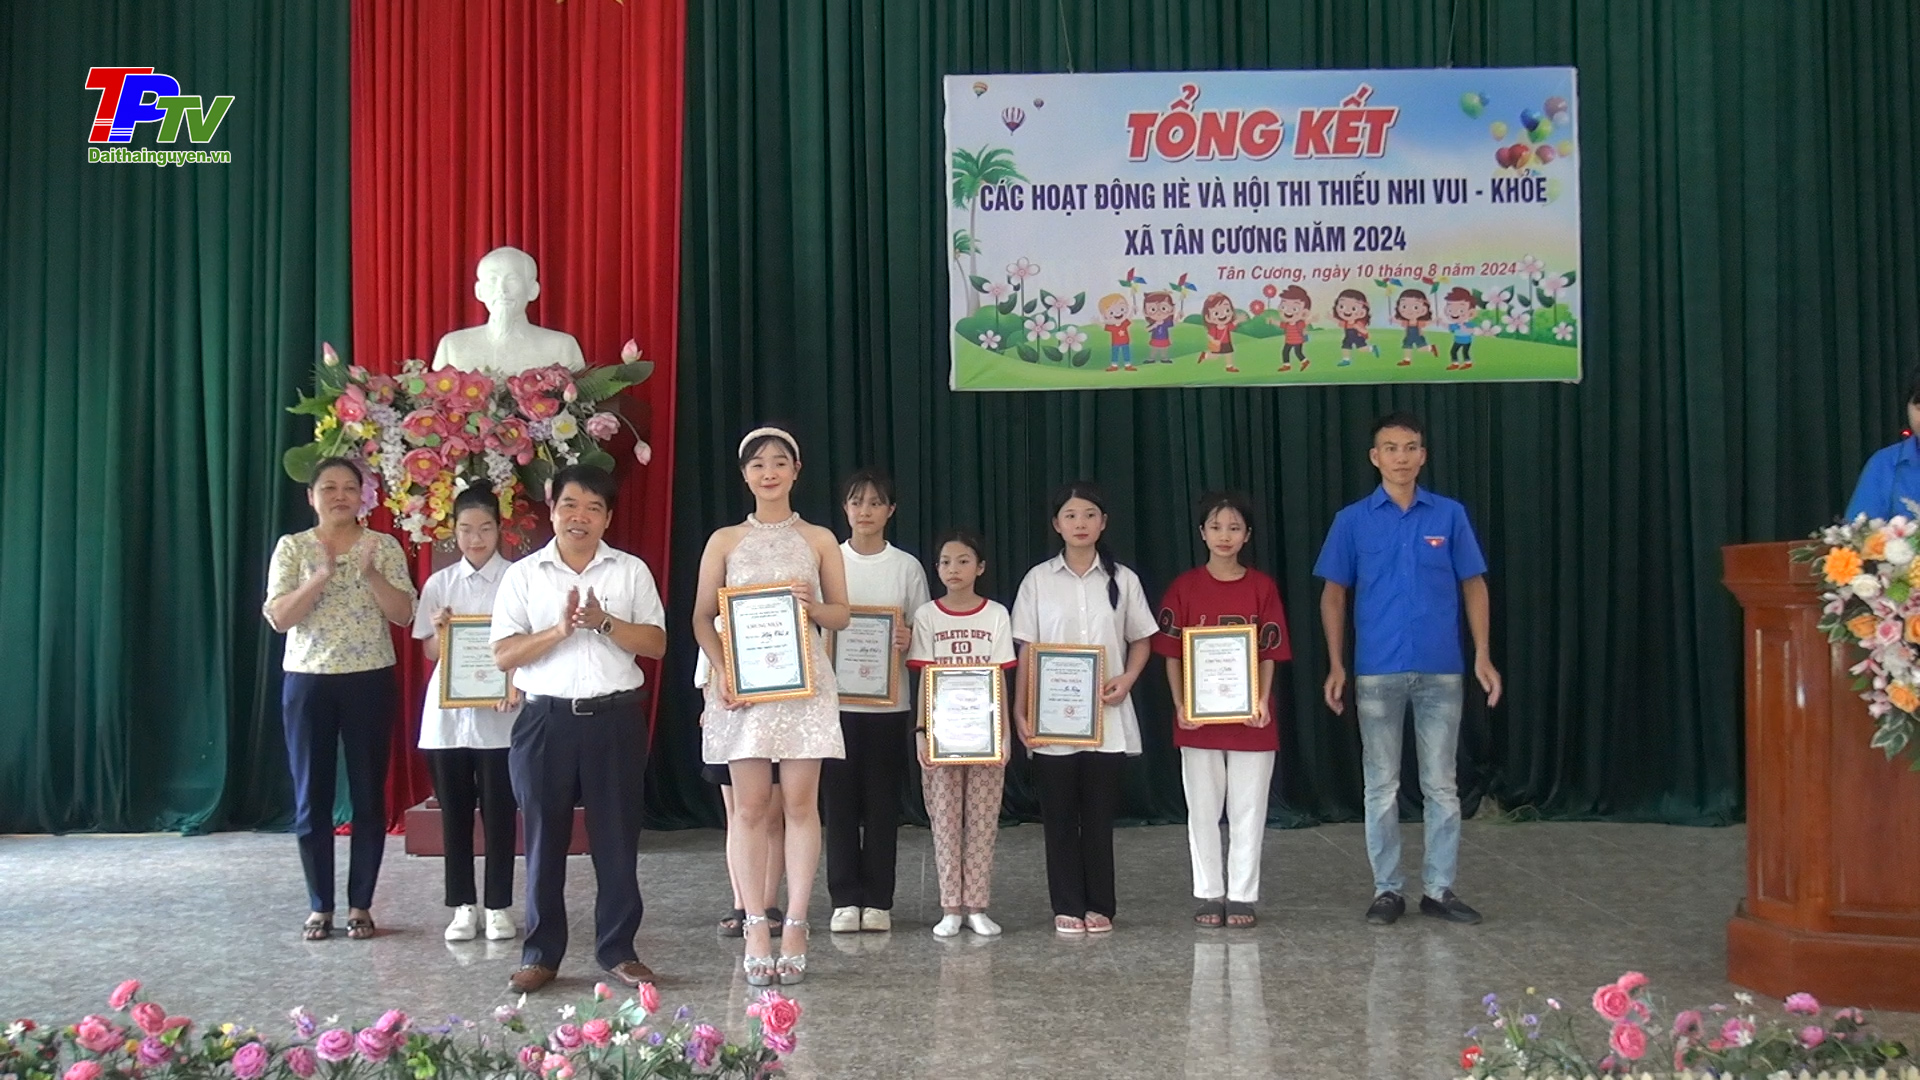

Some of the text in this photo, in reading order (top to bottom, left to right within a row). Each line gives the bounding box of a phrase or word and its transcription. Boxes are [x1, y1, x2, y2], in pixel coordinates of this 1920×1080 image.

[1127, 83, 1398, 161] TỔNG KẾT
[979, 179, 1024, 211] CÁC
[1031, 184, 1088, 216] HOẠT
[1094, 178, 1156, 215] ĐỘNG
[1163, 177, 1190, 209] HÈ
[1198, 176, 1226, 209] VÀ
[1233, 176, 1270, 213] HỘI
[1277, 180, 1311, 207] THI
[1318, 170, 1380, 206] THIẾU
[1388, 178, 1425, 204] NHI
[1433, 178, 1468, 204] VUI
[1491, 168, 1547, 203] KHỎE
[1124, 221, 1406, 256] XÃ TÂN CƯƠNG NĂM 2024
[1217, 262, 1517, 283] Tân Cương, ngày 10 tháng 8 năm 2024
[954, 641, 969, 654] 10
